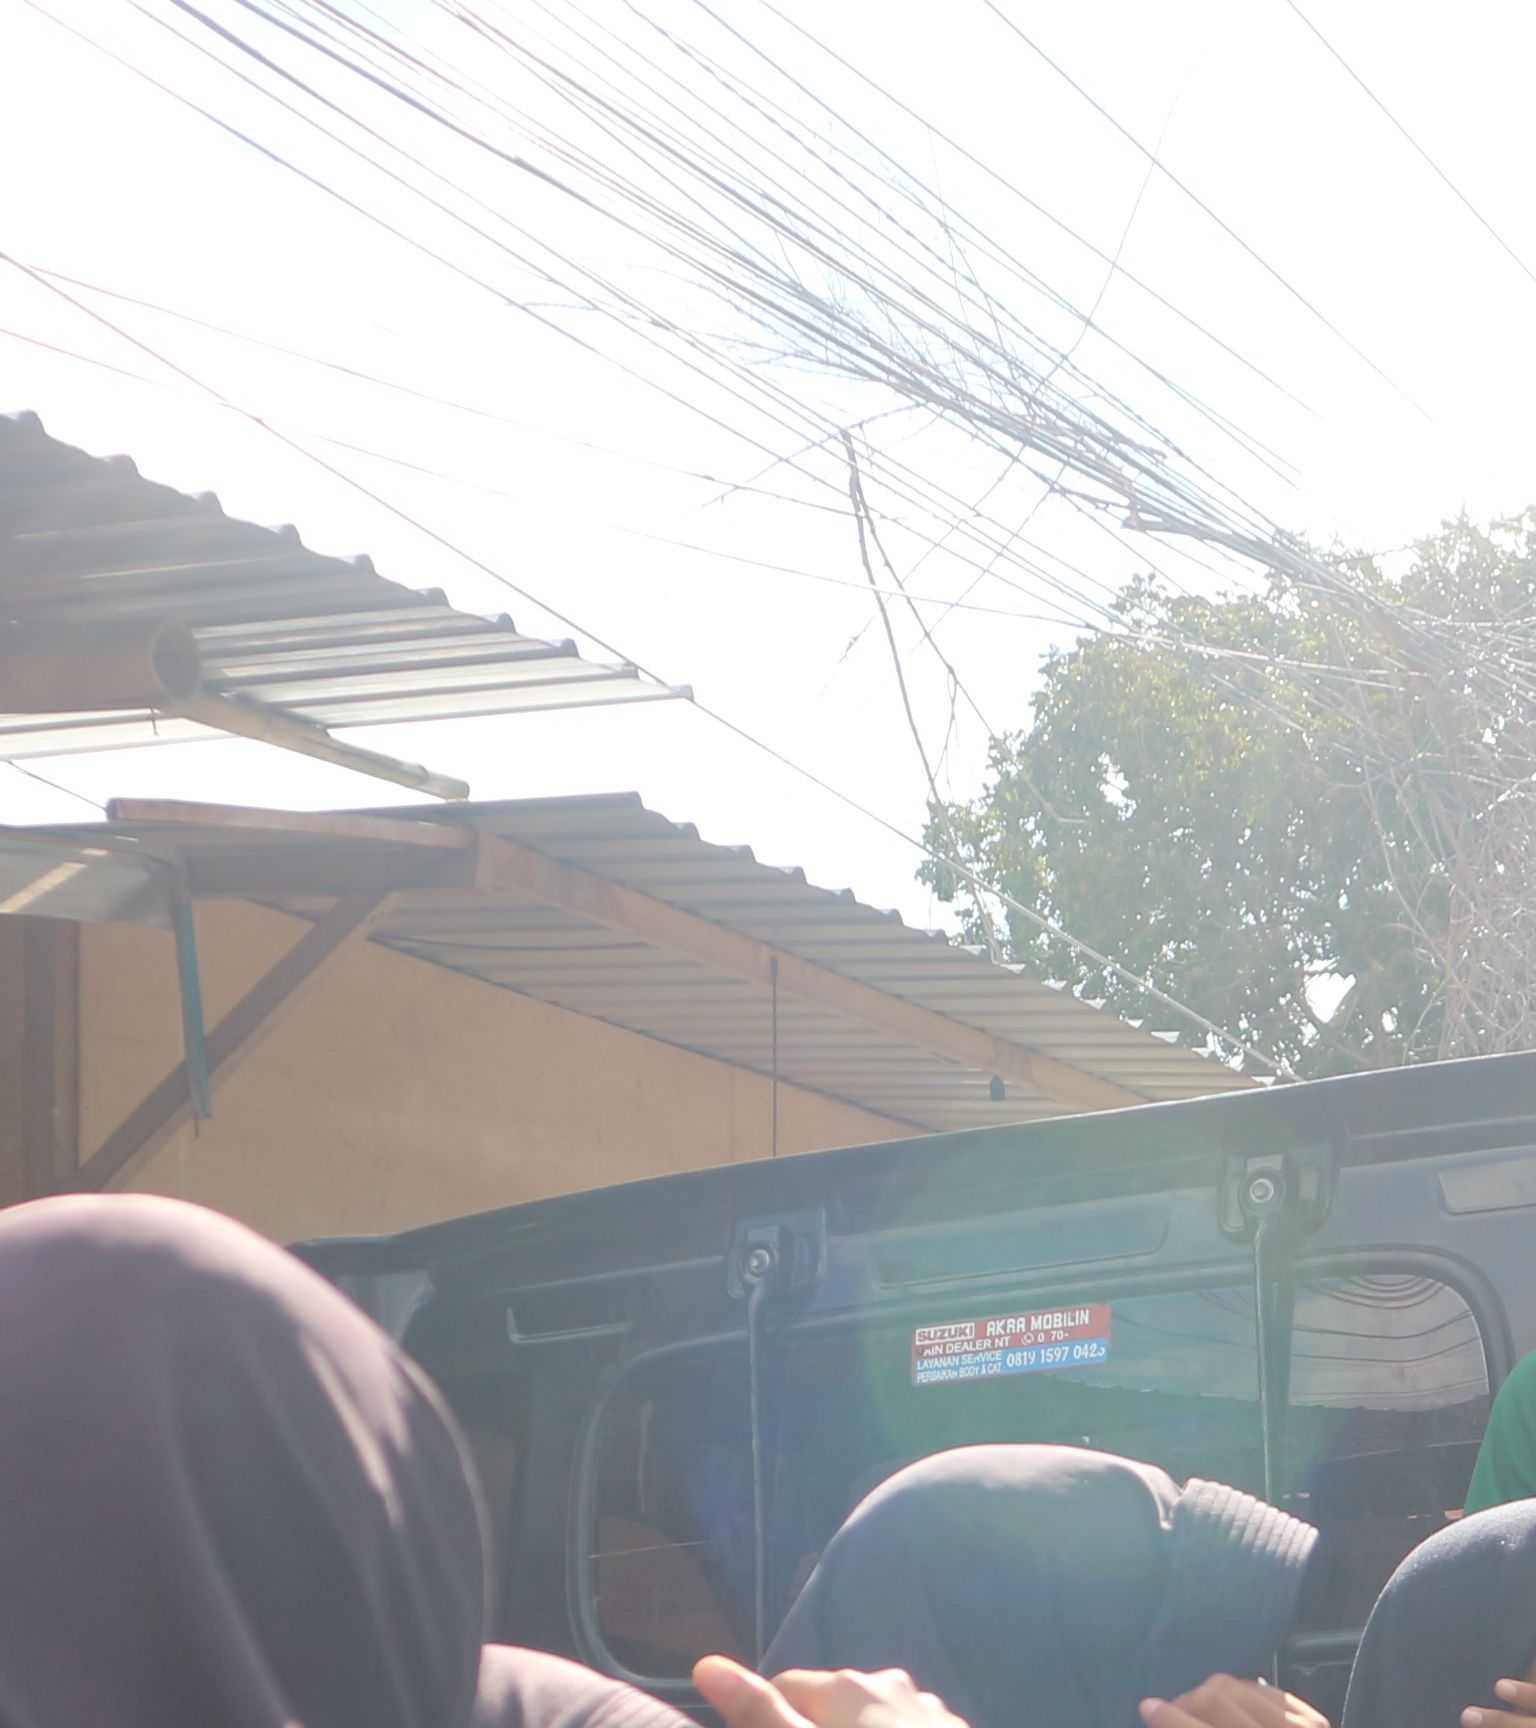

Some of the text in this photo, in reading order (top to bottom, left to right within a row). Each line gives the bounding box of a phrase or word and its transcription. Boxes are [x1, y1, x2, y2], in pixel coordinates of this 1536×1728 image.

[917, 1308, 1090, 1343] SUZUKI AKRA MOBILIN
[917, 1344, 943, 1358] AIN
[945, 1338, 992, 1354] DEALER
[1006, 1350, 1036, 1368] 0819
[1040, 1346, 1070, 1364] 1597
[917, 1350, 1003, 1371] LAYANAN SERVICE
